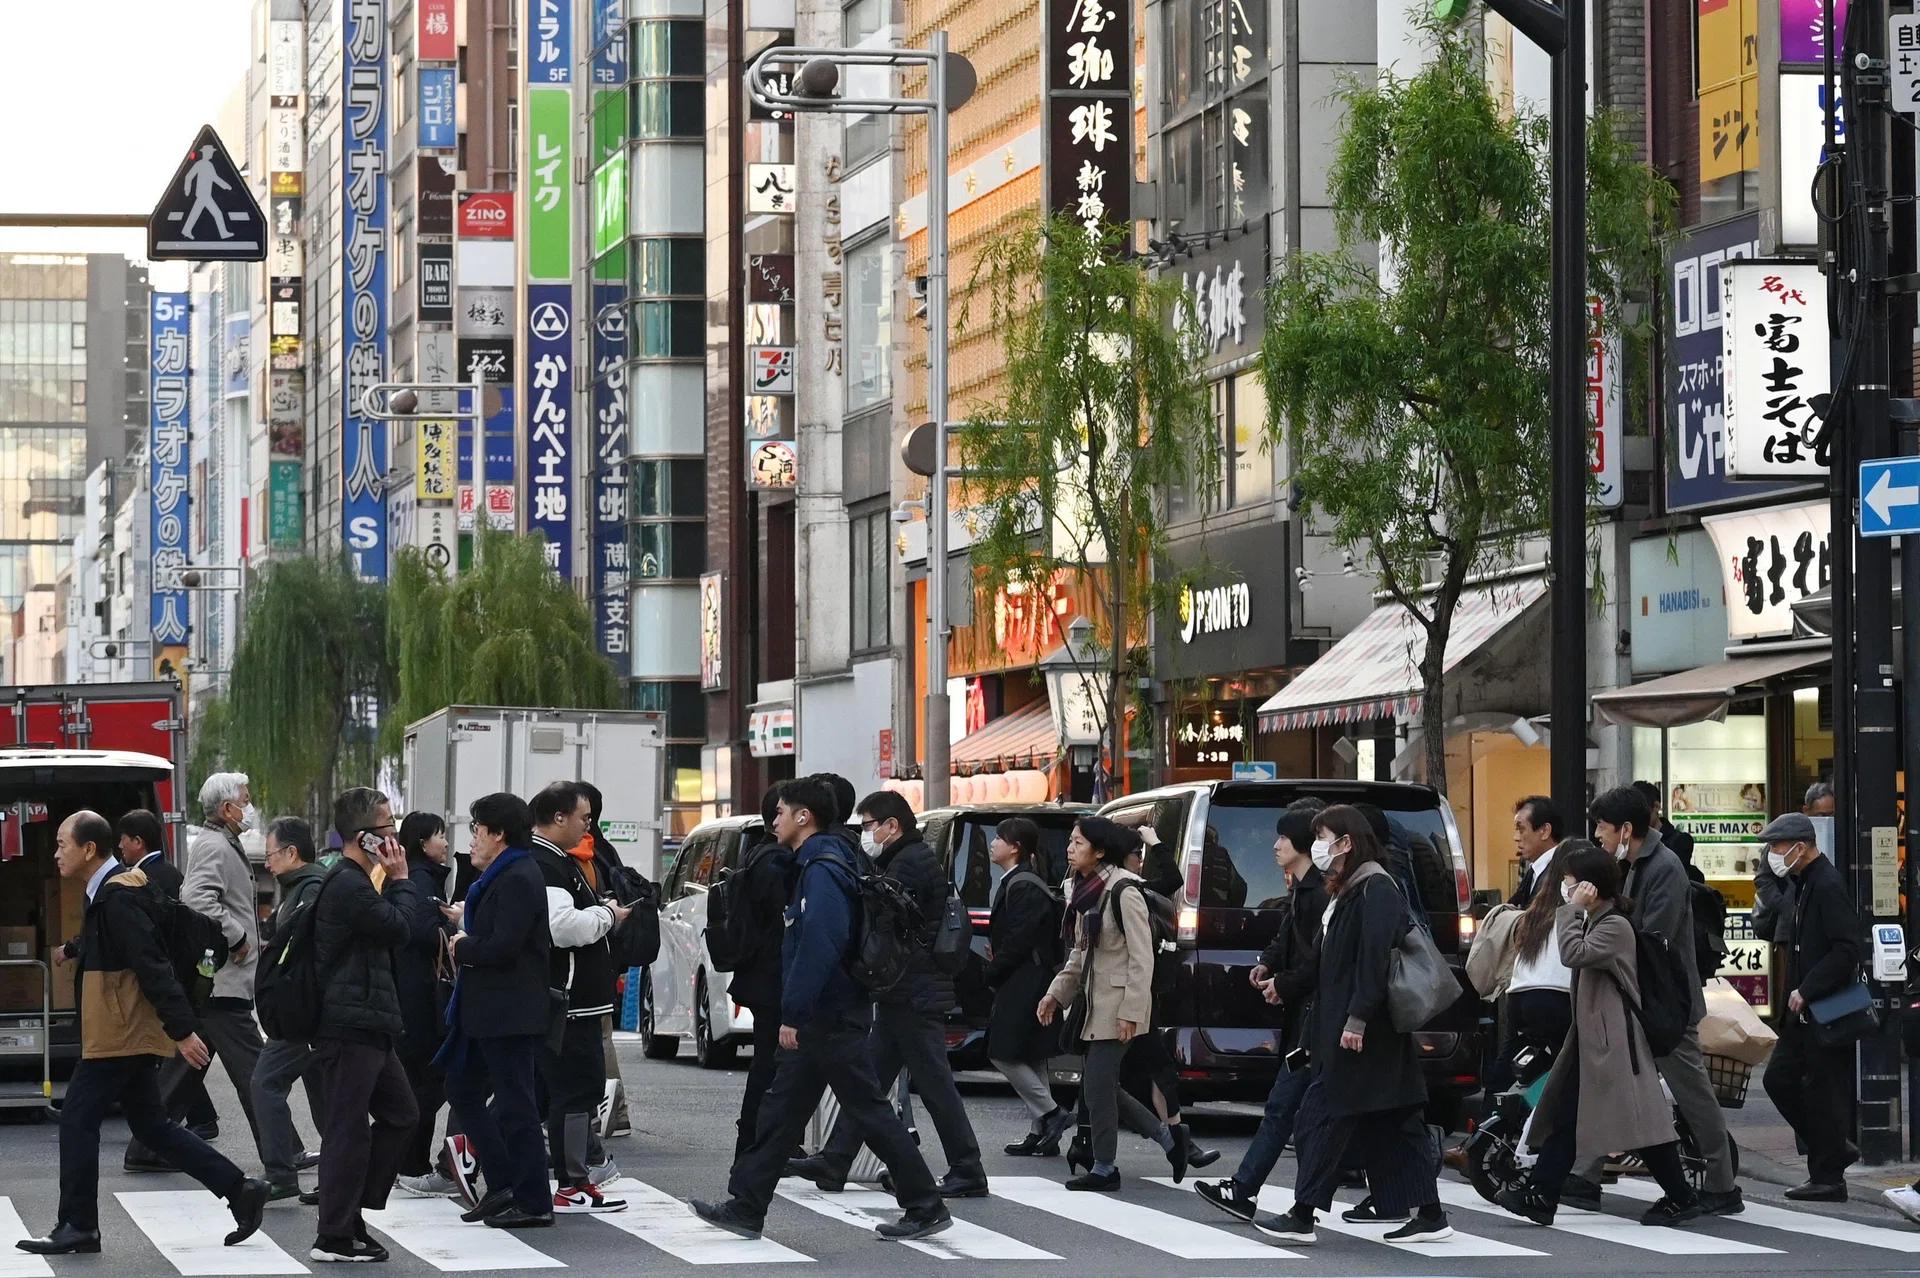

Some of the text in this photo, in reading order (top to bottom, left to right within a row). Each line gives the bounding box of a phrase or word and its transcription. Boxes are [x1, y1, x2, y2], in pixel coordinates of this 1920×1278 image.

[426, 12, 449, 35] 楊
[538, 0, 560, 63] トラル
[1744, 35, 1758, 66] T
[549, 69, 568, 82] 5F
[424, 85, 442, 140] ジロー
[278, 112, 291, 168] とり酒場
[1712, 109, 1759, 161] ジン
[535, 134, 562, 213] レイク
[466, 208, 507, 220] ZINO
[425, 264, 449, 281] BAR
[425, 294, 448, 303] LIGHT
[1757, 275, 1807, 306] 名代
[155, 296, 185, 321] 5F
[533, 354, 568, 521] かんべ土地
[152, 327, 188, 643] カラオケの鉄人
[1196, 582, 1250, 635] PRONTO
[1659, 588, 1700, 614] HANABISI
[1719, 822, 1750, 835] MAX
